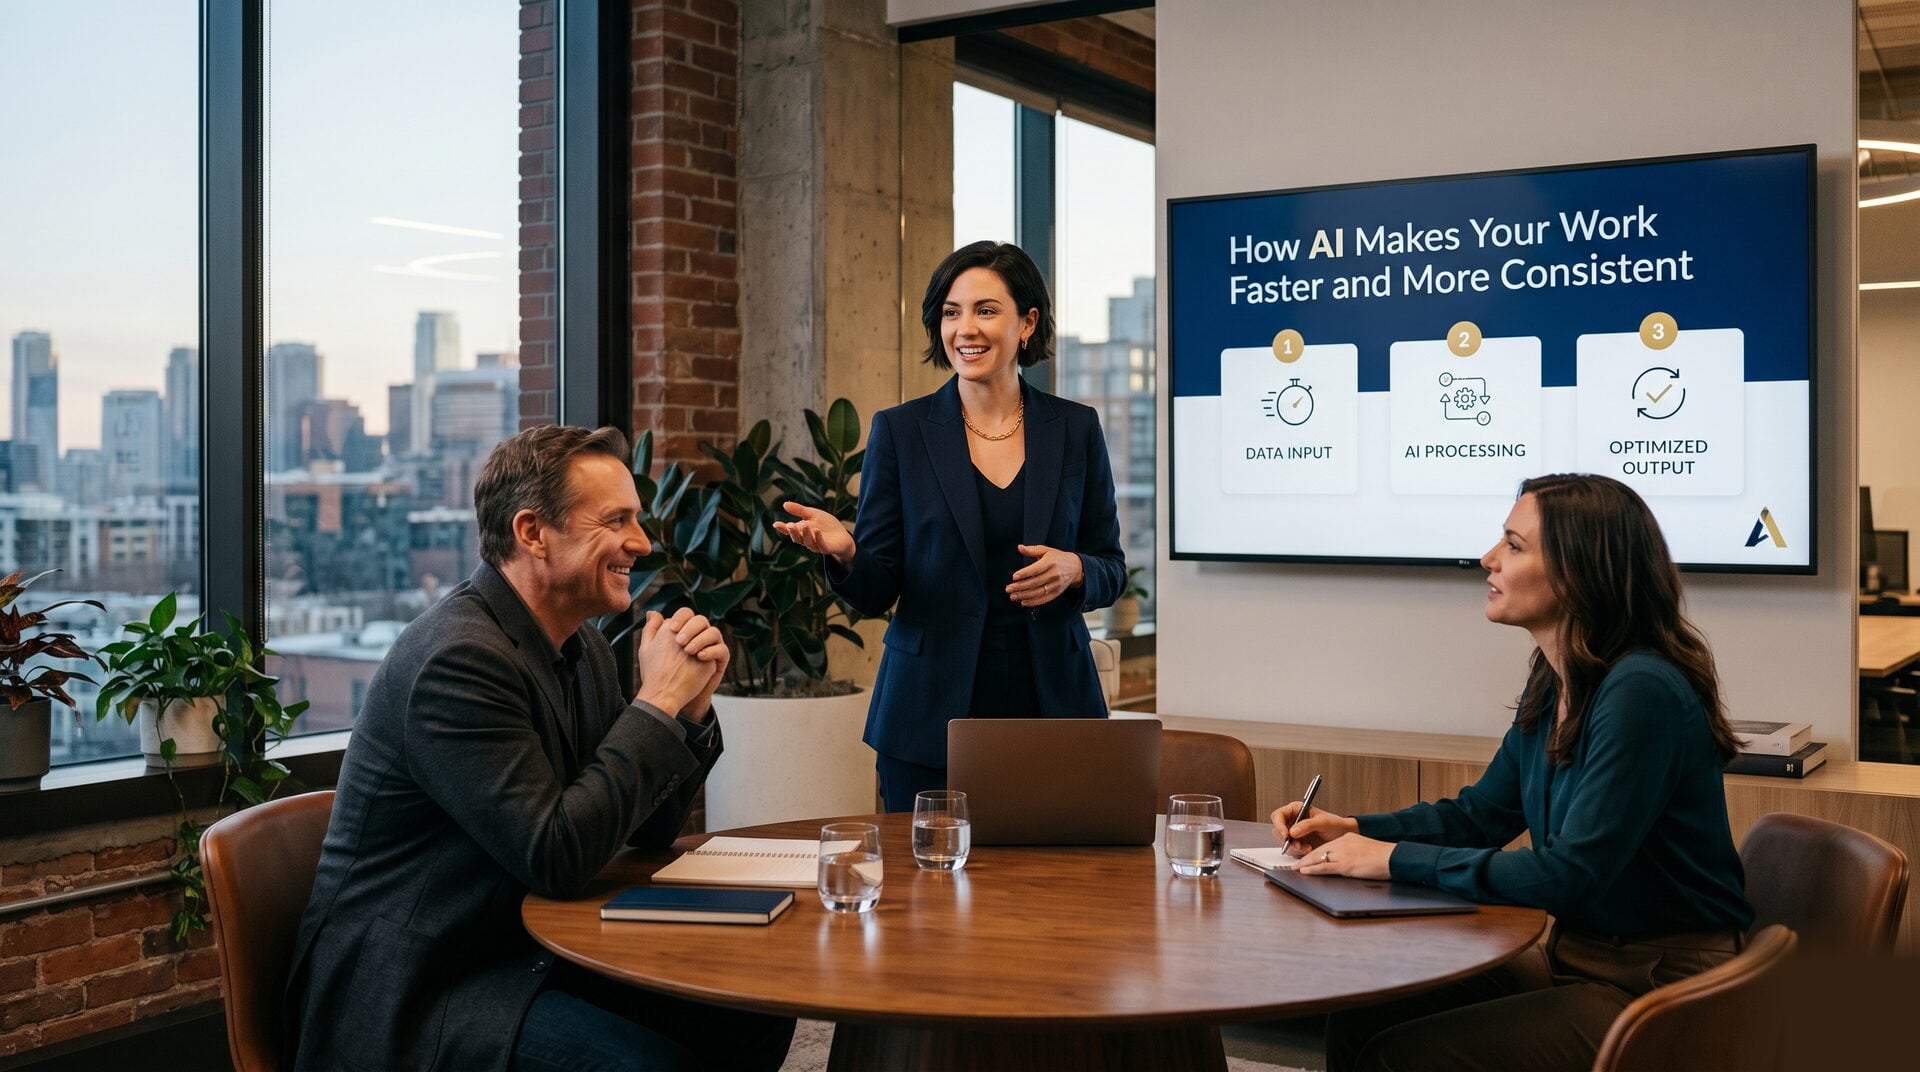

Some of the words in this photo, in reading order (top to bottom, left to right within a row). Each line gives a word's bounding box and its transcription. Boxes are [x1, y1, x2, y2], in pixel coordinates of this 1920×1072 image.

[1229, 234, 1301, 265] How
[1308, 228, 1345, 260] AI
[1356, 222, 1461, 257] Makes
[1469, 214, 1552, 248] Your
[1558, 204, 1659, 242] Work
[1230, 274, 1325, 305] Faster
[1332, 265, 1392, 301] and
[1403, 264, 1491, 296] More
[1500, 250, 1695, 291] Consistent
[1651, 321, 1666, 341] 3
[1282, 339, 1294, 355] 1
[1458, 330, 1471, 349] 2
[1246, 447, 1284, 460] DATA
[1288, 446, 1333, 460] INPUT
[1404, 445, 1420, 458] AI
[1425, 443, 1526, 458] PROCESSING
[1609, 439, 1709, 455] OPTIMIZED
[1622, 460, 1697, 475] OUTPUT
